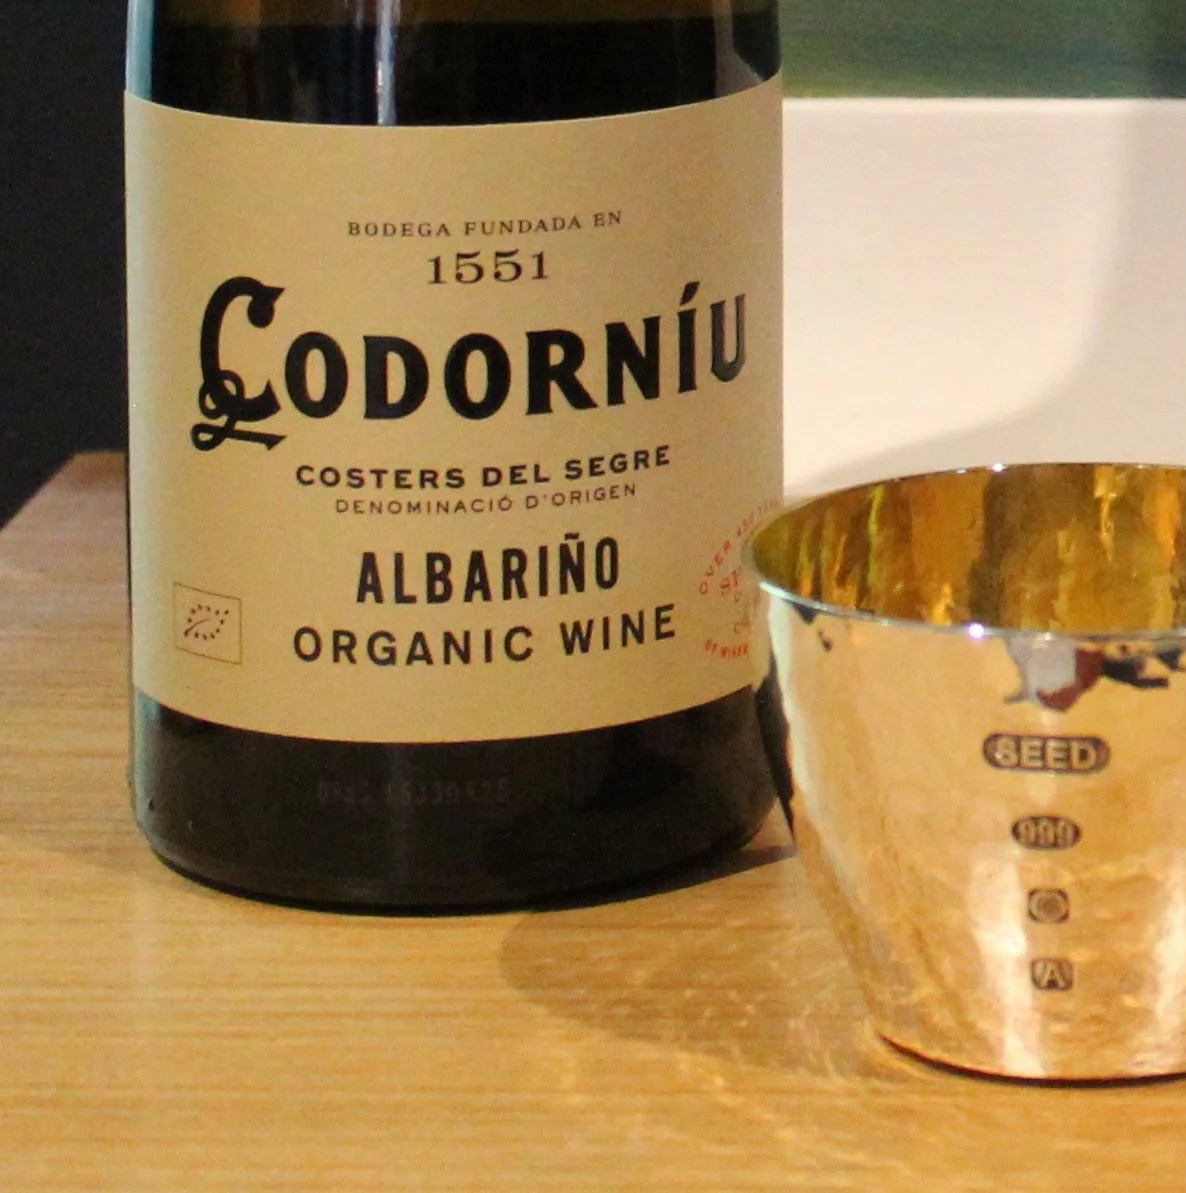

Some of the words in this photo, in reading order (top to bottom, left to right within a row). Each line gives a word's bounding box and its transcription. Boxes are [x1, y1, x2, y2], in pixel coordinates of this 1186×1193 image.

[347, 220, 452, 239] BODEGA
[463, 214, 583, 238] FUNDADA
[592, 209, 623, 229] EN
[427, 247, 550, 285] 1551
[190, 275, 747, 452] CODORNÍU
[295, 463, 466, 491] COSTERS
[481, 462, 551, 488] DEL
[563, 444, 671, 482] SEGRE
[334, 495, 514, 515] DENOMINACIÓ
[525, 482, 637, 511] D'ORIGEN
[355, 530, 620, 606] ALBARIÑO
[292, 624, 535, 668] ORGANIC
[558, 602, 677, 657] WINE
[994, 736, 1098, 771] SEED
[1037, 960, 1068, 990] A
